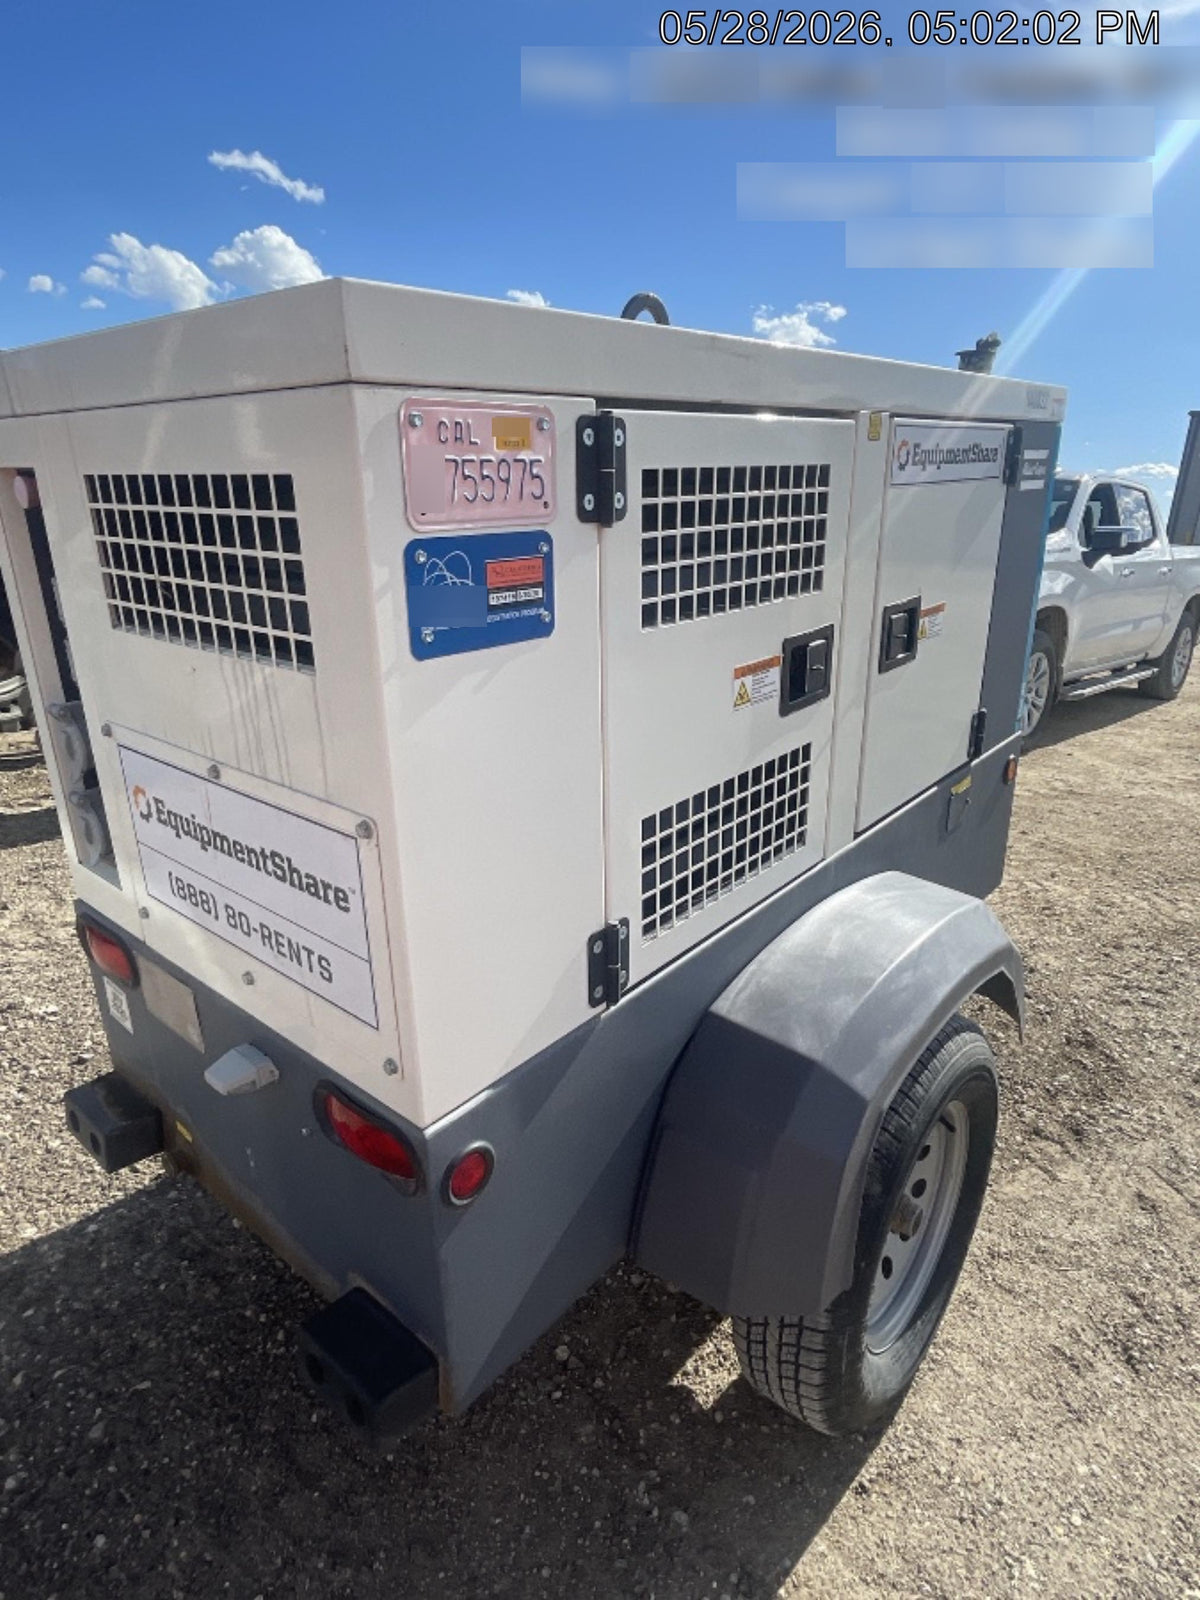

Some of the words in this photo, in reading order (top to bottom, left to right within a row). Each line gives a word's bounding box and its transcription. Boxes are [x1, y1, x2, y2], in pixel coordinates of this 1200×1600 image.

[437, 417, 481, 446] CAL
[911, 442, 999, 470] EquipmentShare
[444, 454, 545, 504] 755975
[153, 796, 351, 914] EquipmentShare
[168, 871, 219, 921] (888)
[225, 904, 334, 984] 80-RENTS
